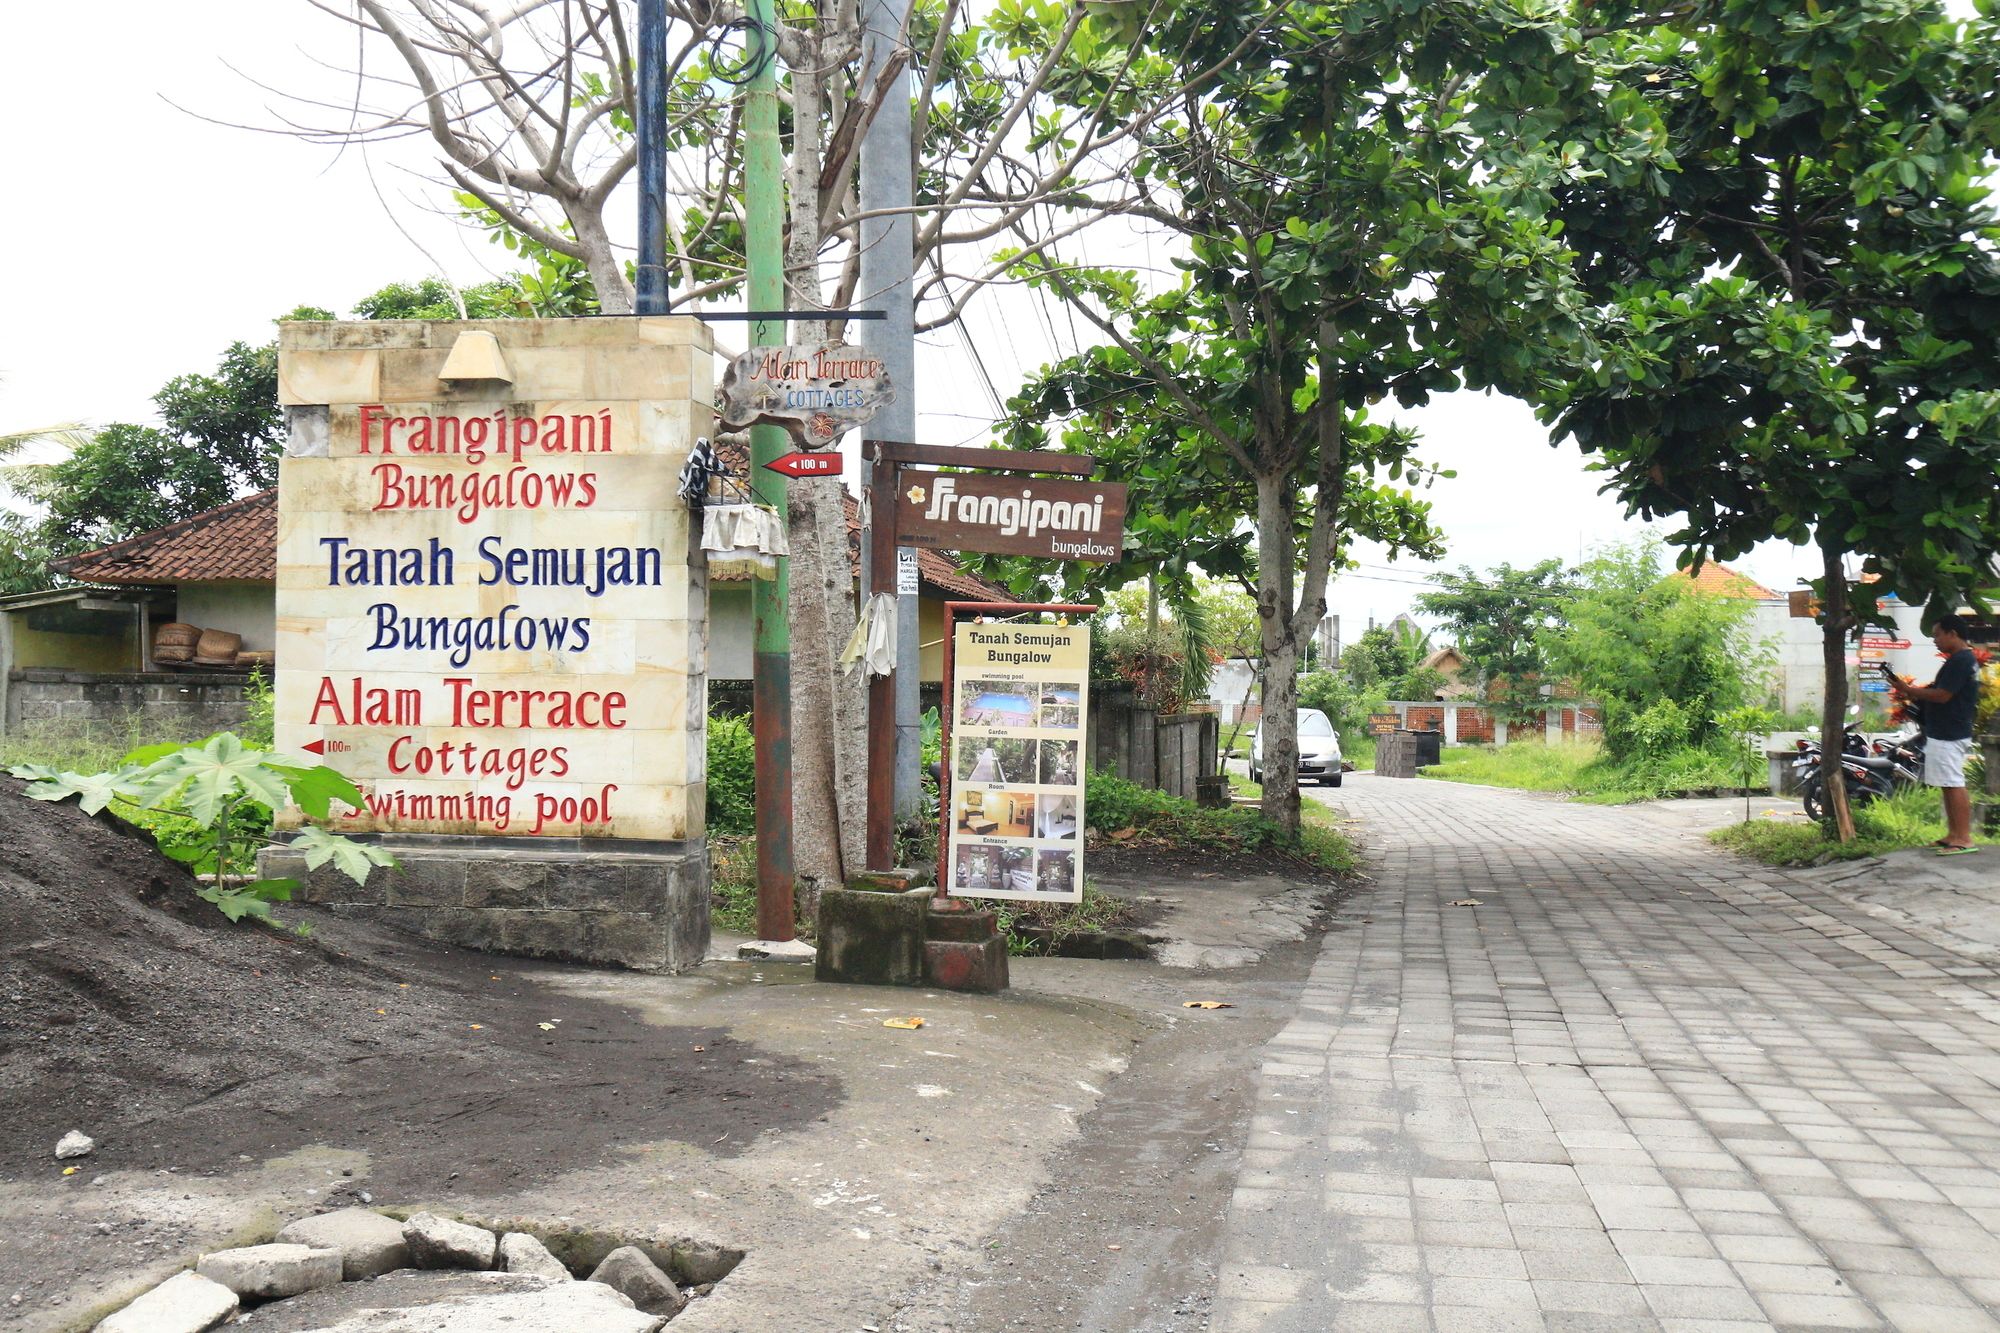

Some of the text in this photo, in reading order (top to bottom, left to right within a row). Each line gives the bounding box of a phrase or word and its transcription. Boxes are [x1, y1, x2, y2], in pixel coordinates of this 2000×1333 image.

[750, 348, 878, 380] Alam Terrace
[786, 389, 866, 409] COTTAGES
[358, 405, 613, 464] Frangipani
[800, 458, 828, 470] 100 m
[371, 462, 597, 525] Bungalows
[924, 477, 1104, 538] Frangipani
[319, 535, 663, 598] Tanah Semujan
[1052, 535, 1115, 558] bungalows
[366, 602, 591, 670] Bungalows
[969, 632, 1070, 648] Tanah Semujan
[987, 650, 1052, 664] Bungalow
[309, 676, 628, 730] Alam Terrace
[387, 735, 571, 791] Cottages
[528, 783, 619, 836] pool
[982, 837, 1008, 845] Entrance
